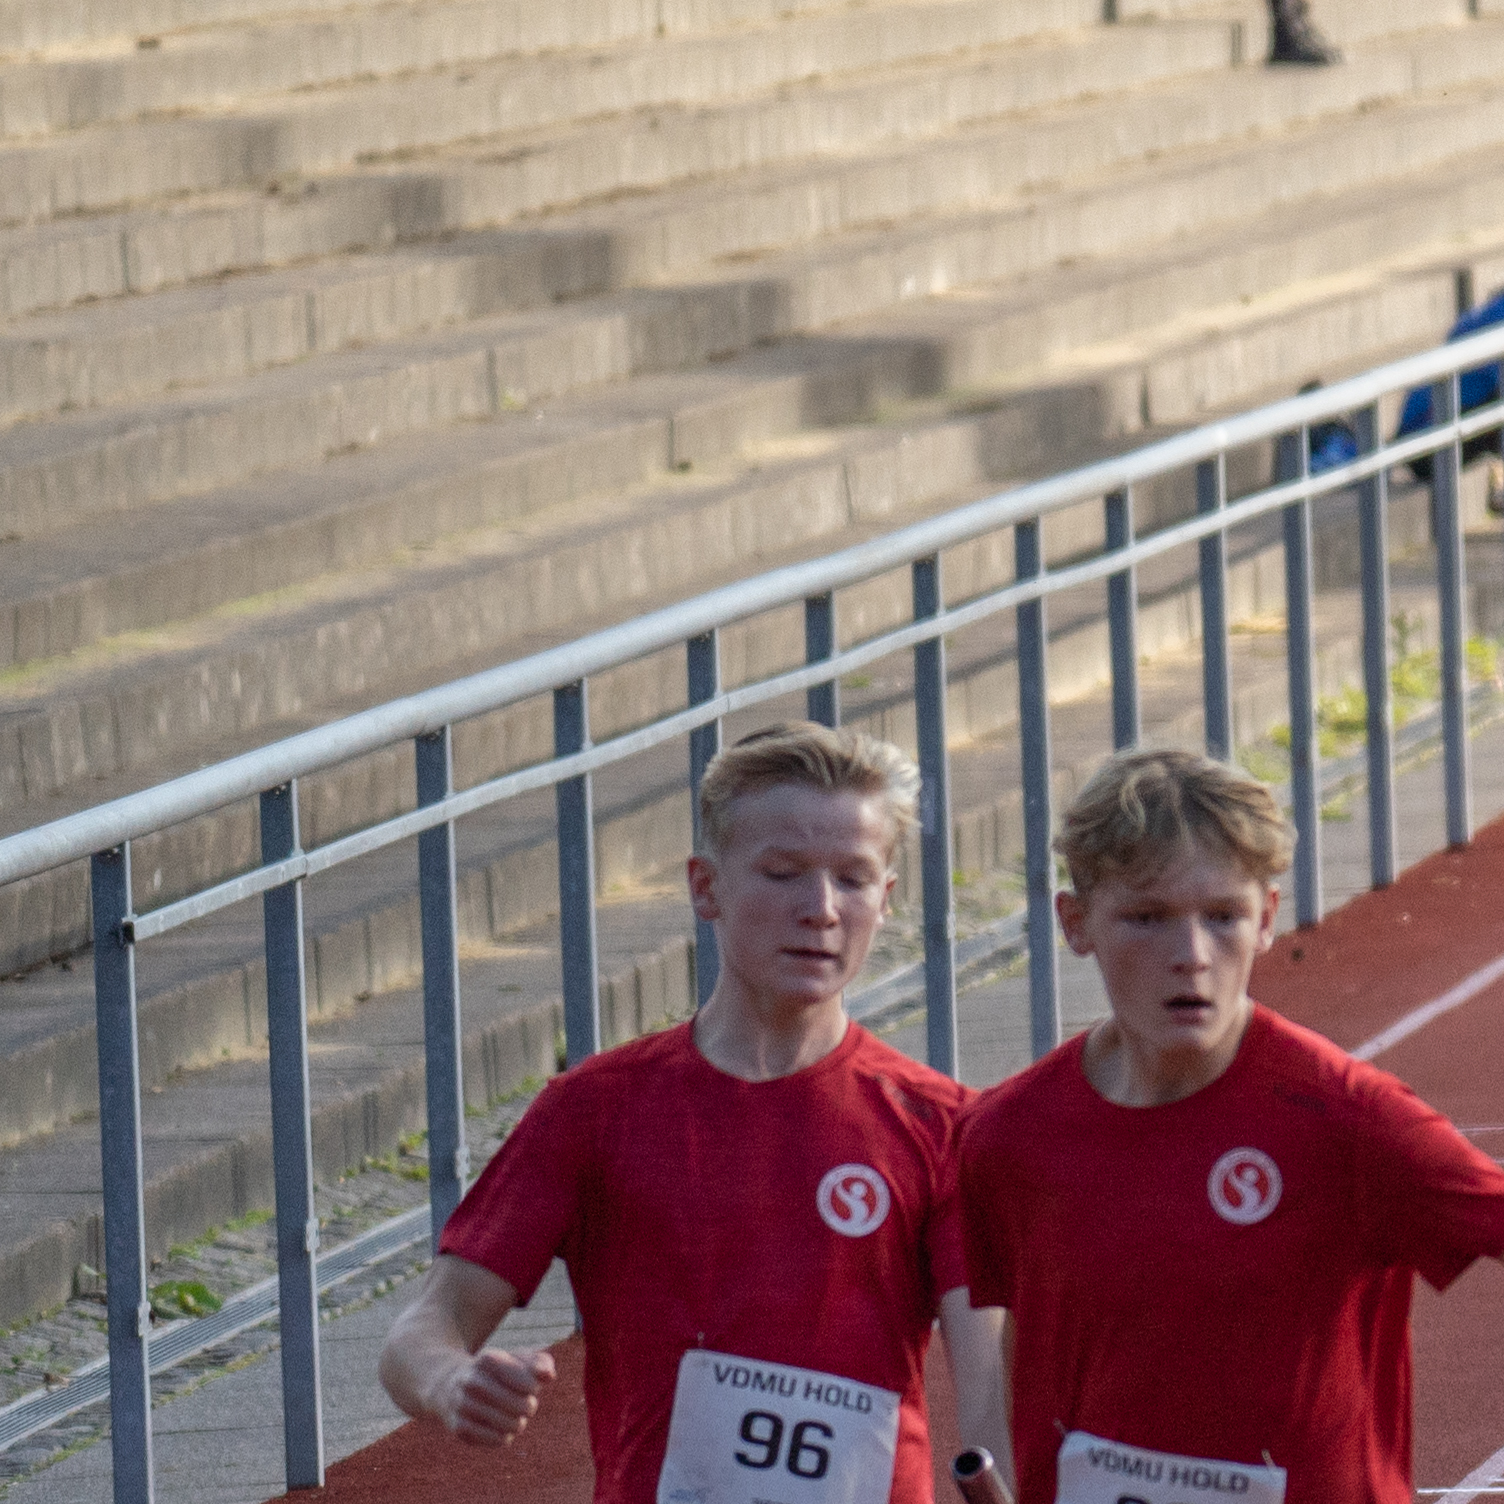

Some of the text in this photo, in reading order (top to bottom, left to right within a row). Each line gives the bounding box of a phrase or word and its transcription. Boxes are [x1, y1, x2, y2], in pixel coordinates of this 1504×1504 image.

[713, 1362, 873, 1414] VDMU HOLD
[734, 1409, 834, 1479] 96
[1087, 1447, 1249, 1494] VDMU HOLD
